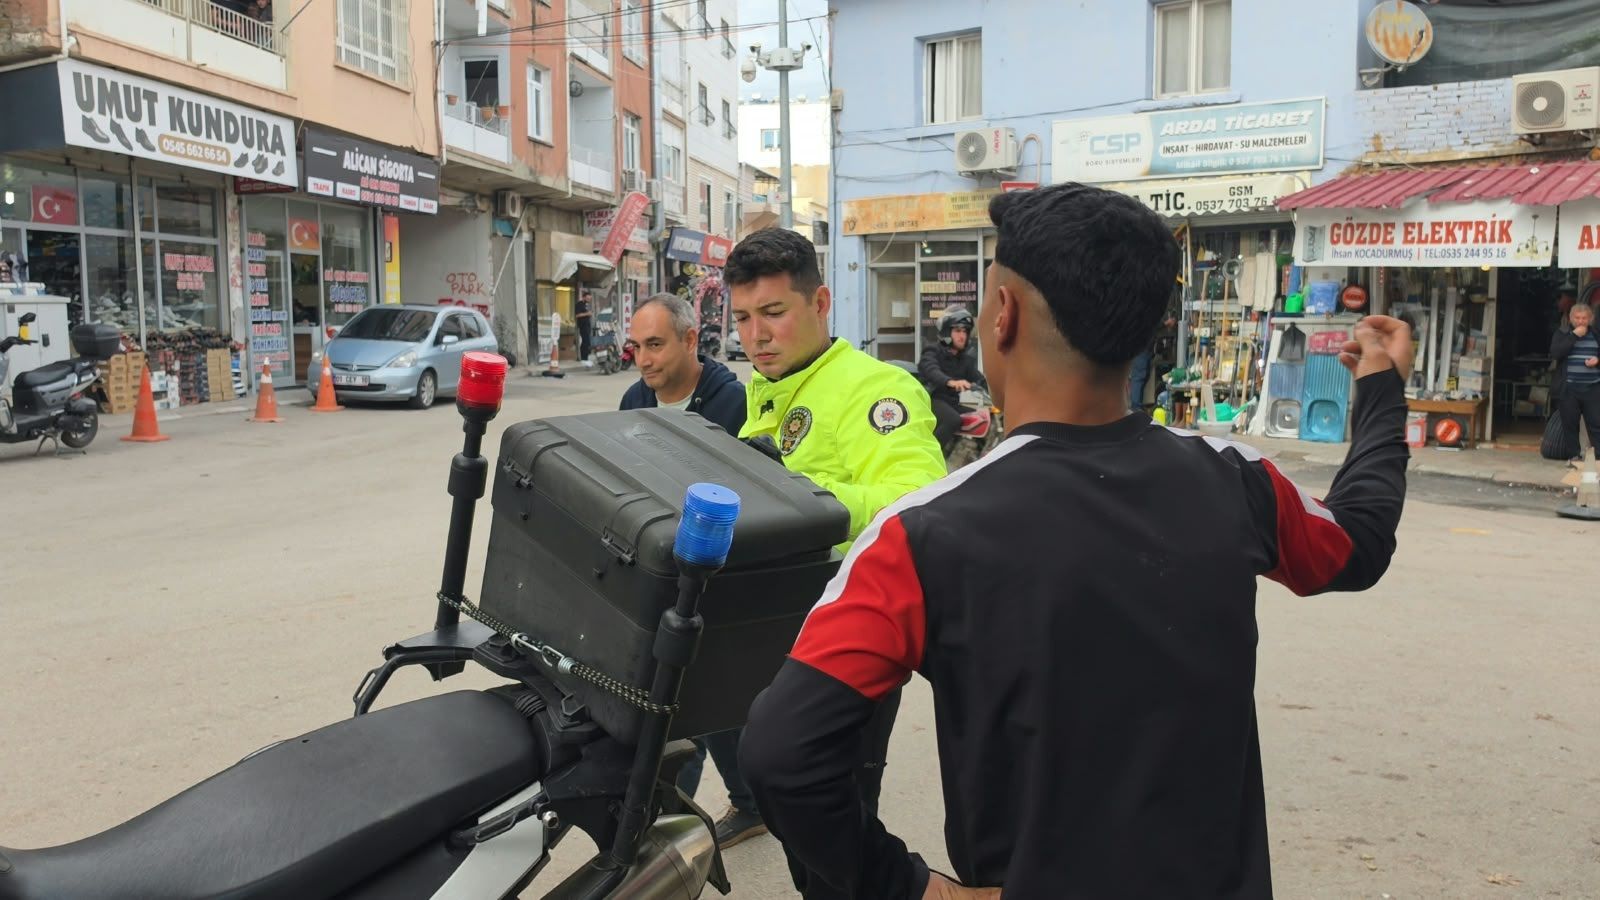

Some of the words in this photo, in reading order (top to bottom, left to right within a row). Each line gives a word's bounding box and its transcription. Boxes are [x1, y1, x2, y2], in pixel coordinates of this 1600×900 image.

[73, 71, 158, 127] UMUT
[168, 95, 286, 157] KUNDURA
[1160, 118, 1217, 137] ARDA
[1224, 110, 1313, 131] TİCARET
[163, 138, 185, 154] 0545
[1090, 132, 1141, 154] CSP
[1163, 144, 1189, 155] İNŞAAT
[1196, 140, 1233, 152] HIRDAVAT
[1240, 139, 1250, 150] SU
[1252, 134, 1307, 147] MALZEMELERİ
[343, 147, 377, 175] ALİCAN
[379, 155, 414, 183] SİGORTA
[1150, 189, 1191, 211] TİC.
[1229, 185, 1253, 196] GSM
[1196, 200, 1223, 211] 0537
[1229, 198, 1249, 208] 703
[1254, 196, 1267, 206] 76
[1330, 216, 1396, 245] GÖZDE
[1402, 213, 1513, 245] ELEKTRİK
[1332, 248, 1352, 258] İhsan
[1355, 248, 1413, 261] KOCADURMUŞ
[1425, 248, 1461, 259] TEL:0535
[1465, 248, 1480, 258] 244
[1483, 248, 1493, 258] 95
[1496, 248, 1507, 258] 16
[446, 272, 477, 284] OTO
[450, 282, 487, 296] PARK
